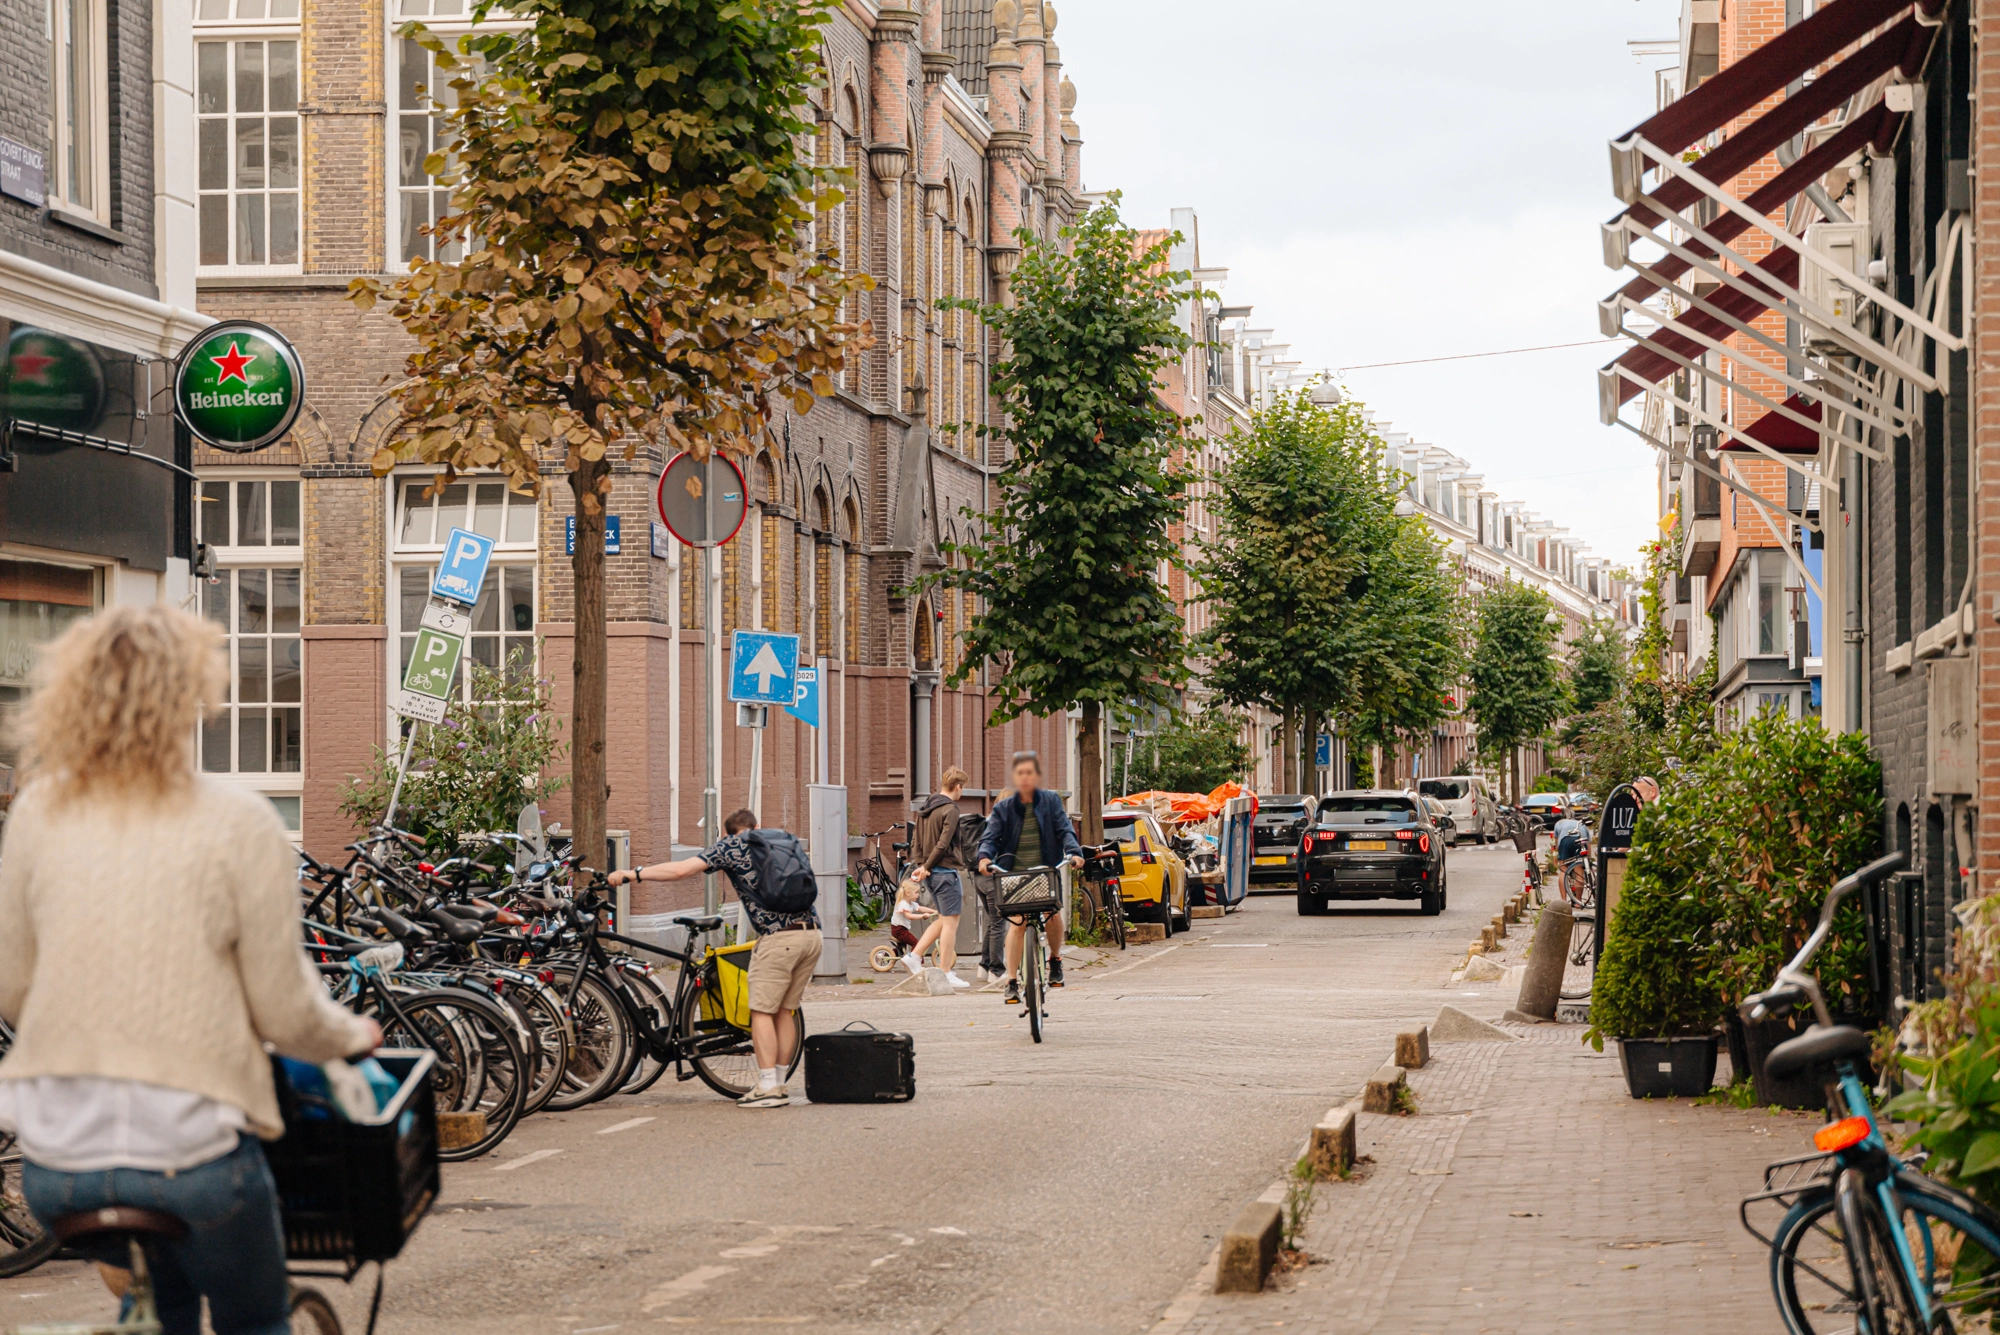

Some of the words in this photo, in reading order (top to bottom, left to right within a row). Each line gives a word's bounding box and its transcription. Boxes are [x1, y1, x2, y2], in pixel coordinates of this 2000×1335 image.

[1, 140, 22, 161] GOVERT
[1, 160, 21, 181] STRAAT
[190, 389, 284, 409] Heineken
[451, 536, 481, 568] P
[424, 636, 448, 662] P
[410, 710, 438, 721] weekend
[1612, 807, 1635, 829] LUZ
